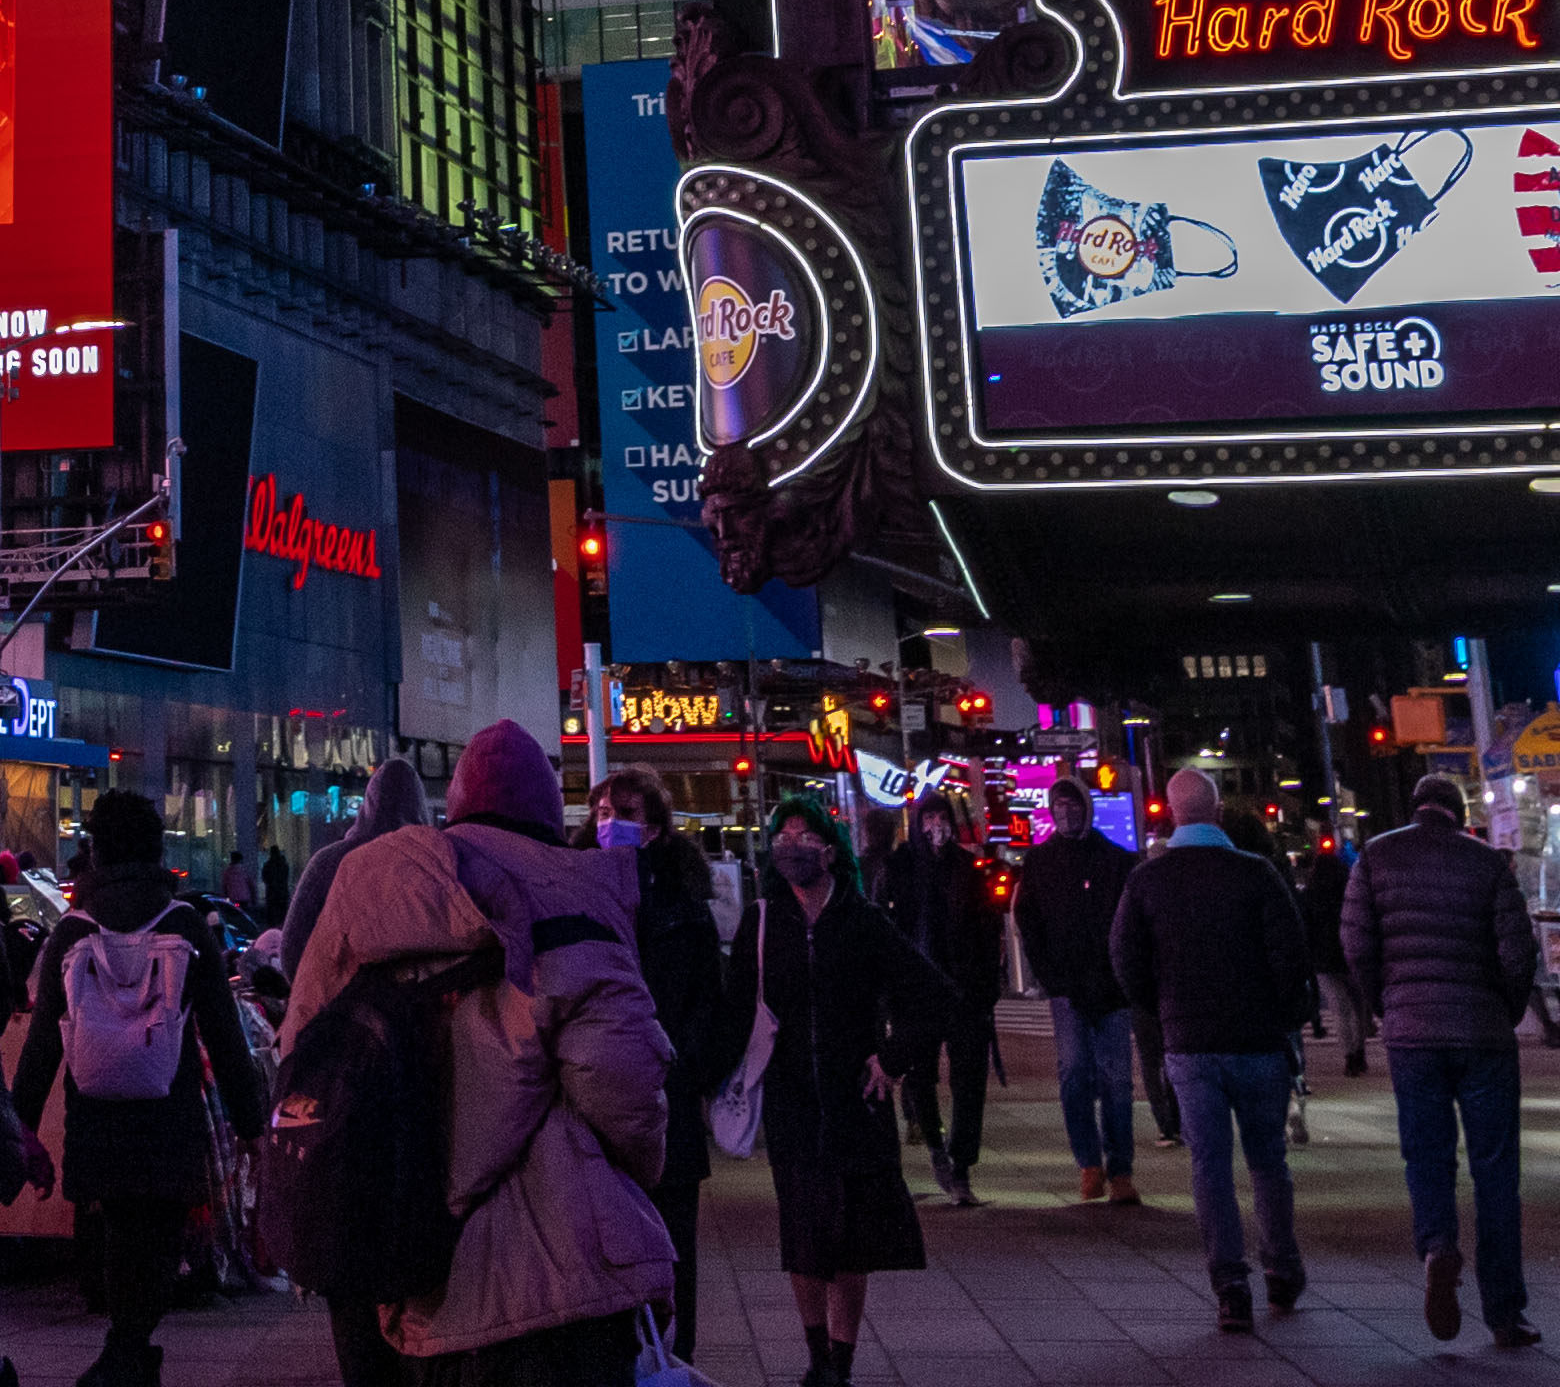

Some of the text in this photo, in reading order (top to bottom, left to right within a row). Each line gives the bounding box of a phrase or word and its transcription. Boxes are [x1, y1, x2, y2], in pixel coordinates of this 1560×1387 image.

[1305, 196, 1400, 274] Hard Rock
[608, 271, 648, 294] TO
[718, 289, 796, 345] Rock
[30, 343, 99, 377] SOON
[709, 349, 736, 368] CAFE
[1319, 358, 1445, 392] SOUND
[244, 472, 383, 591] Walgreens
